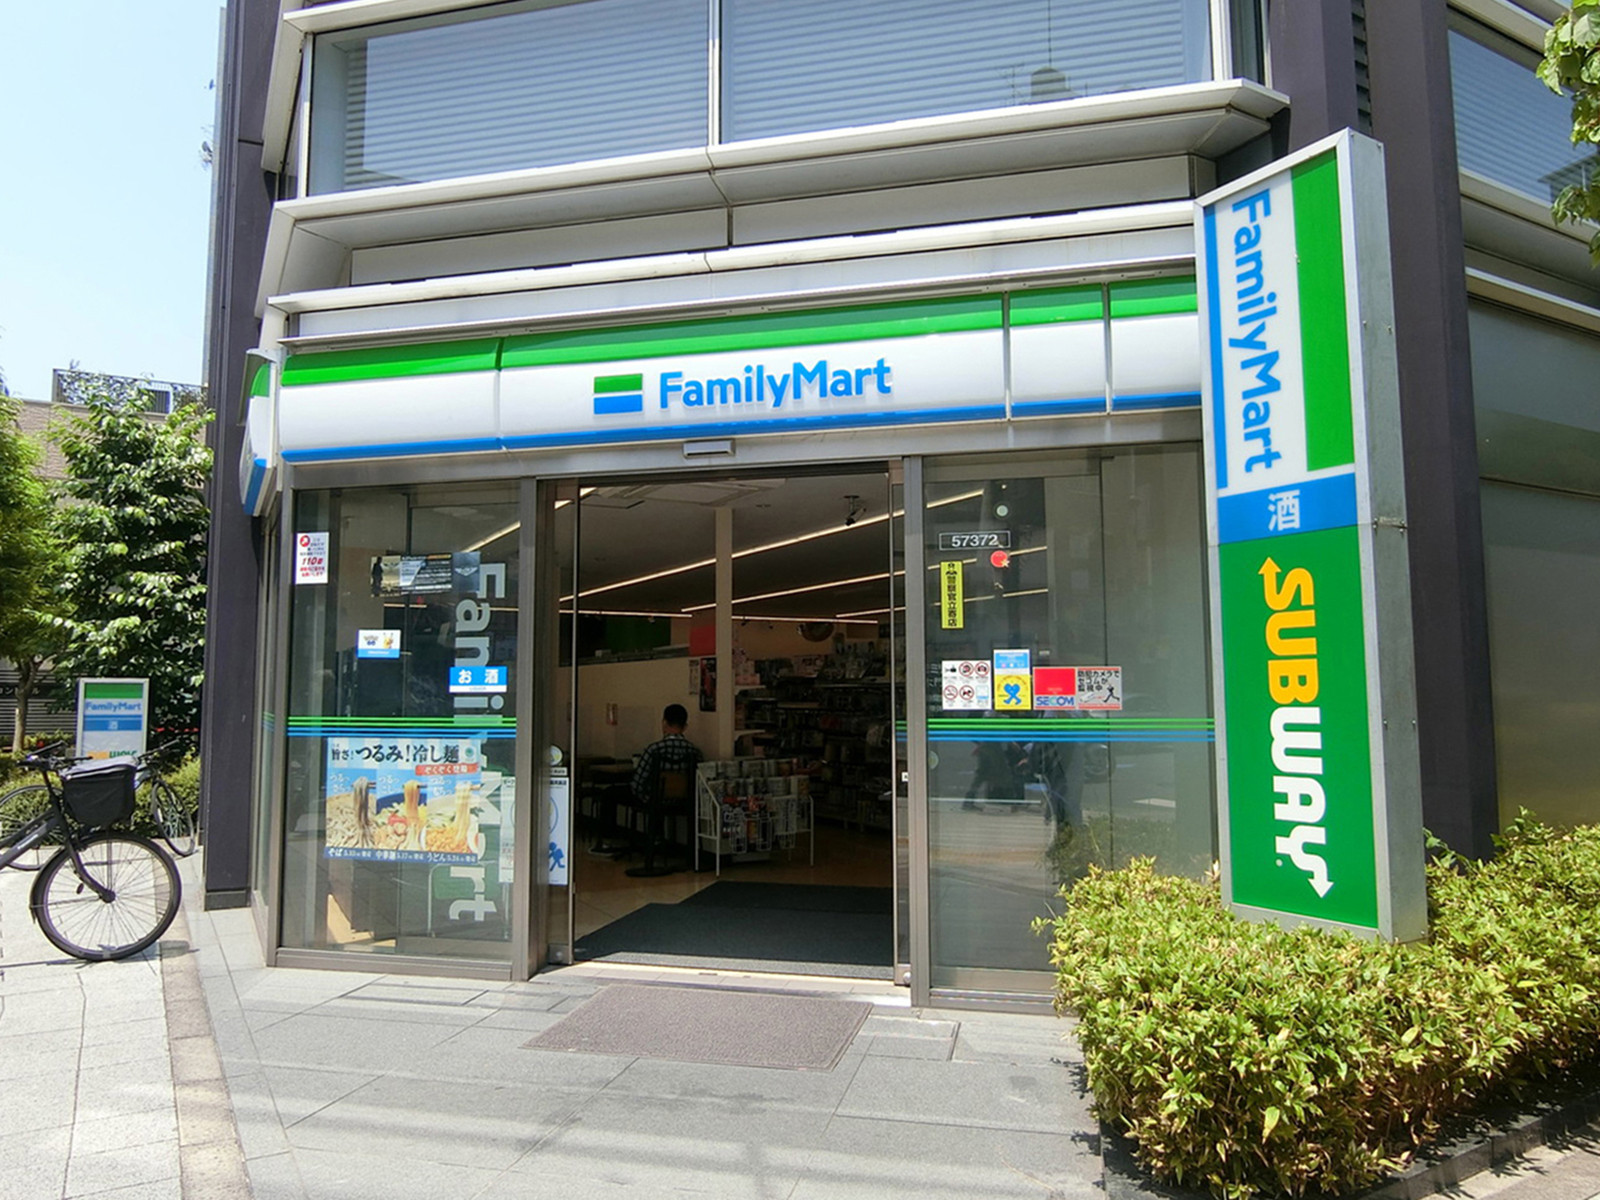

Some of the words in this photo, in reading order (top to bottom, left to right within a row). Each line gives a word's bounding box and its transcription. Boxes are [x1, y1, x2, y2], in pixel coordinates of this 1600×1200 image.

[1228, 188, 1283, 474] FamilyMart
[659, 357, 892, 409] FamilyMart
[1267, 489, 1301, 532] 酒
[951, 533, 999, 548] 57372
[457, 668, 499, 684] お酒
[85, 701, 142, 712] FamilyMart
[1035, 695, 1075, 706] SECOM
[449, 563, 506, 922] Familrt
[1258, 557, 1334, 898] SUBWAY
